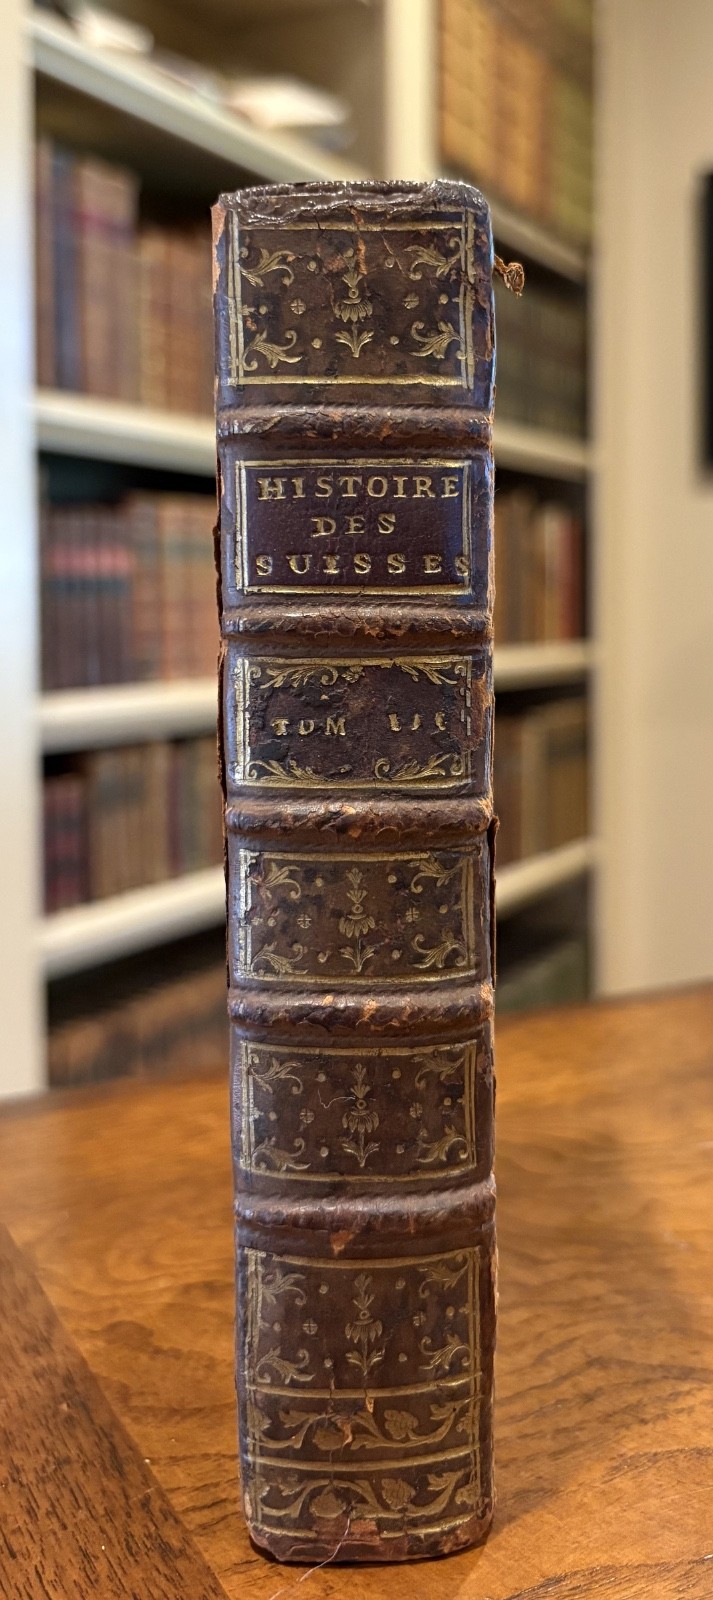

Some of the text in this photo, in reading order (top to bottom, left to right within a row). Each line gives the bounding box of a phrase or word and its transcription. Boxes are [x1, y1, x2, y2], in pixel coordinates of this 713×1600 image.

[257, 475, 460, 500] HISTOIRE
[310, 513, 396, 537] DES
[255, 553, 470, 577] SUISSES
